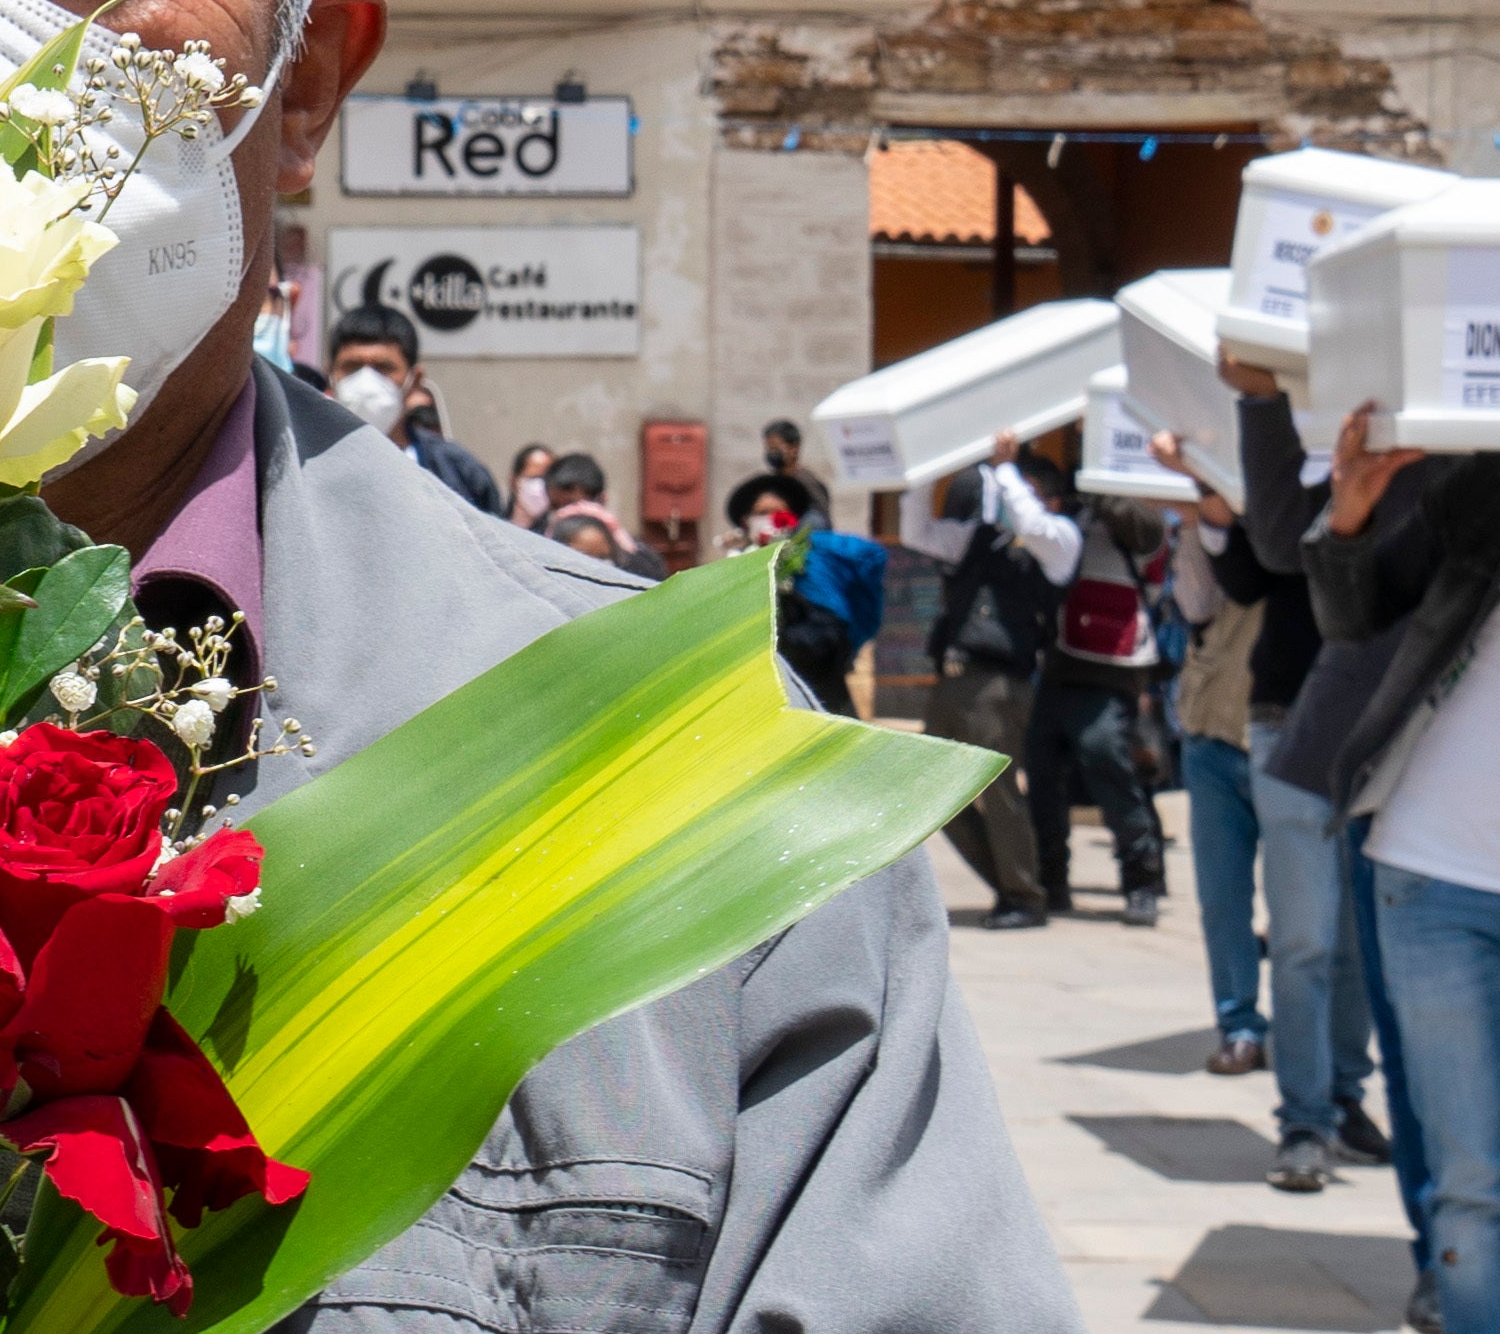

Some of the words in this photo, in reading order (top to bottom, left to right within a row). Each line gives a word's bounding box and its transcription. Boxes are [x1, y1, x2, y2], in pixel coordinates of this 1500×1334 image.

[413, 109, 561, 178] Red
[148, 239, 197, 276] KN95
[489, 261, 546, 288] Café
[485, 298, 636, 320] restaurante
